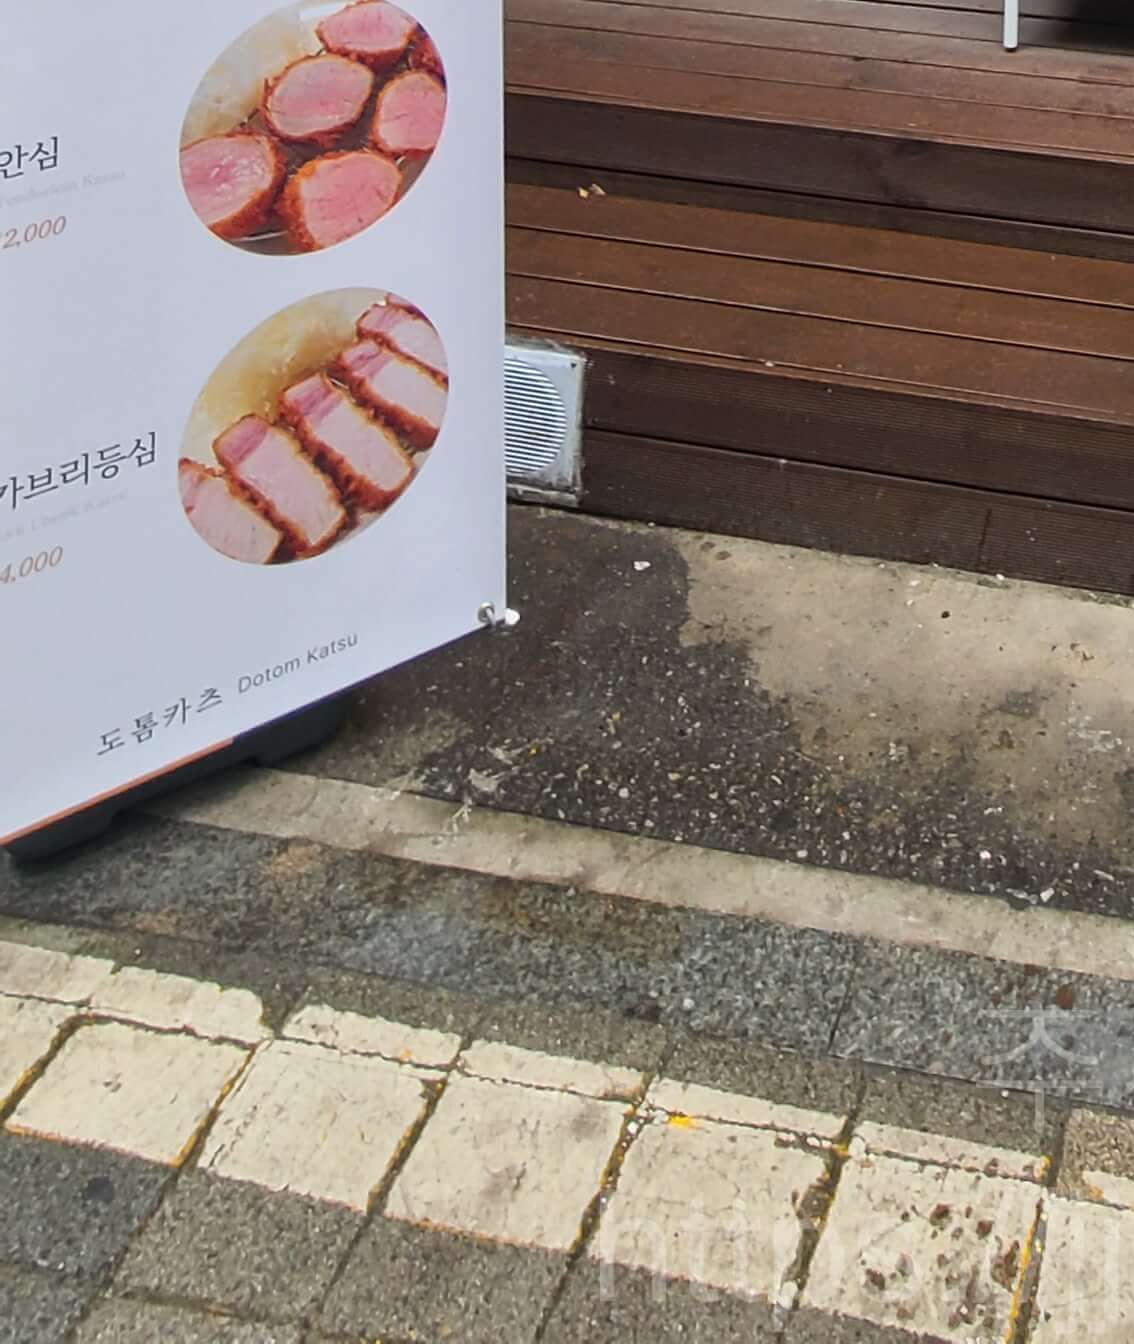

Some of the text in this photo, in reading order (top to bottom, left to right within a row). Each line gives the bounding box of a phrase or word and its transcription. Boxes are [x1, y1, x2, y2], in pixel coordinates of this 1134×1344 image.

[0, 136, 59, 180] 안심
[0, 215, 67, 250] 2,000
[0, 431, 156, 510] 가브리등심
[96, 632, 359, 756] 도톰카츠 Dotom Katsu
